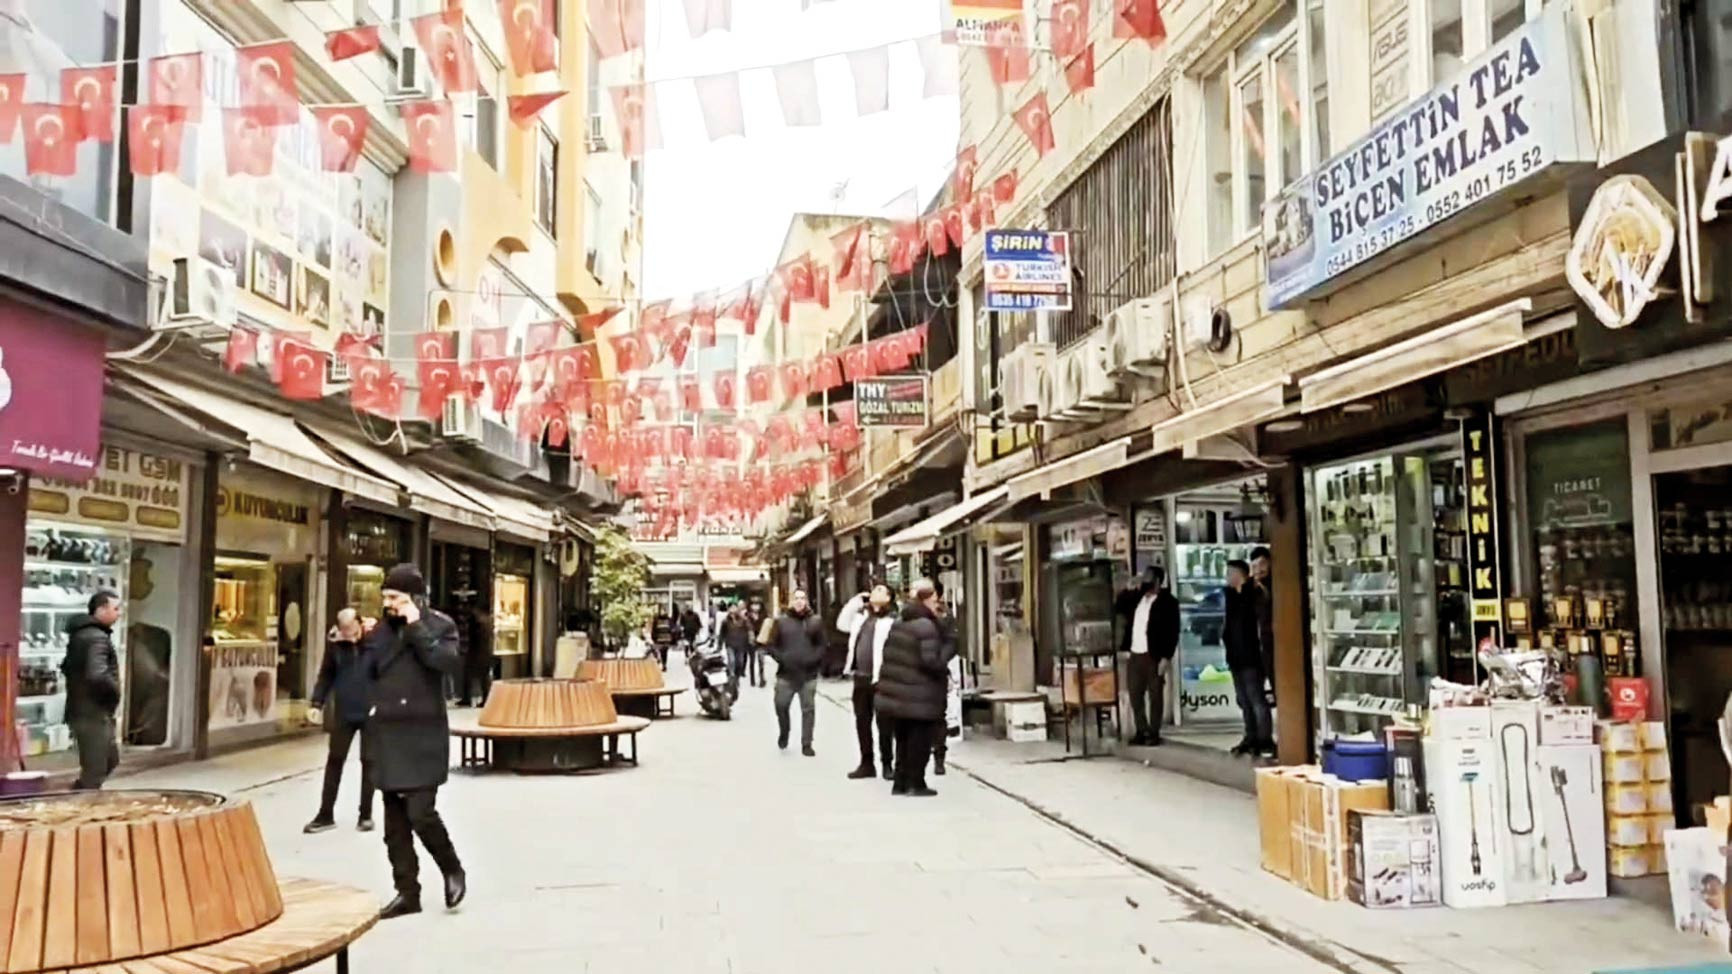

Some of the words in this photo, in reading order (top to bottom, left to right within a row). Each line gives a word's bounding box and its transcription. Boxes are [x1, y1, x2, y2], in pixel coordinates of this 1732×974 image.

[1470, 36, 1541, 109] TEA
[1414, 95, 1529, 195] EMLAK
[1381, 226, 1394, 248] 37
[1400, 215, 1415, 237] 25
[1426, 192, 1460, 222] 0552
[1465, 175, 1490, 202] 401
[1497, 160, 1516, 184] 75
[1522, 146, 1543, 172] 52
[858, 382, 886, 398] THY
[105, 445, 131, 473] ET
[139, 452, 182, 483] GSM
[1180, 689, 1229, 712] dyson
